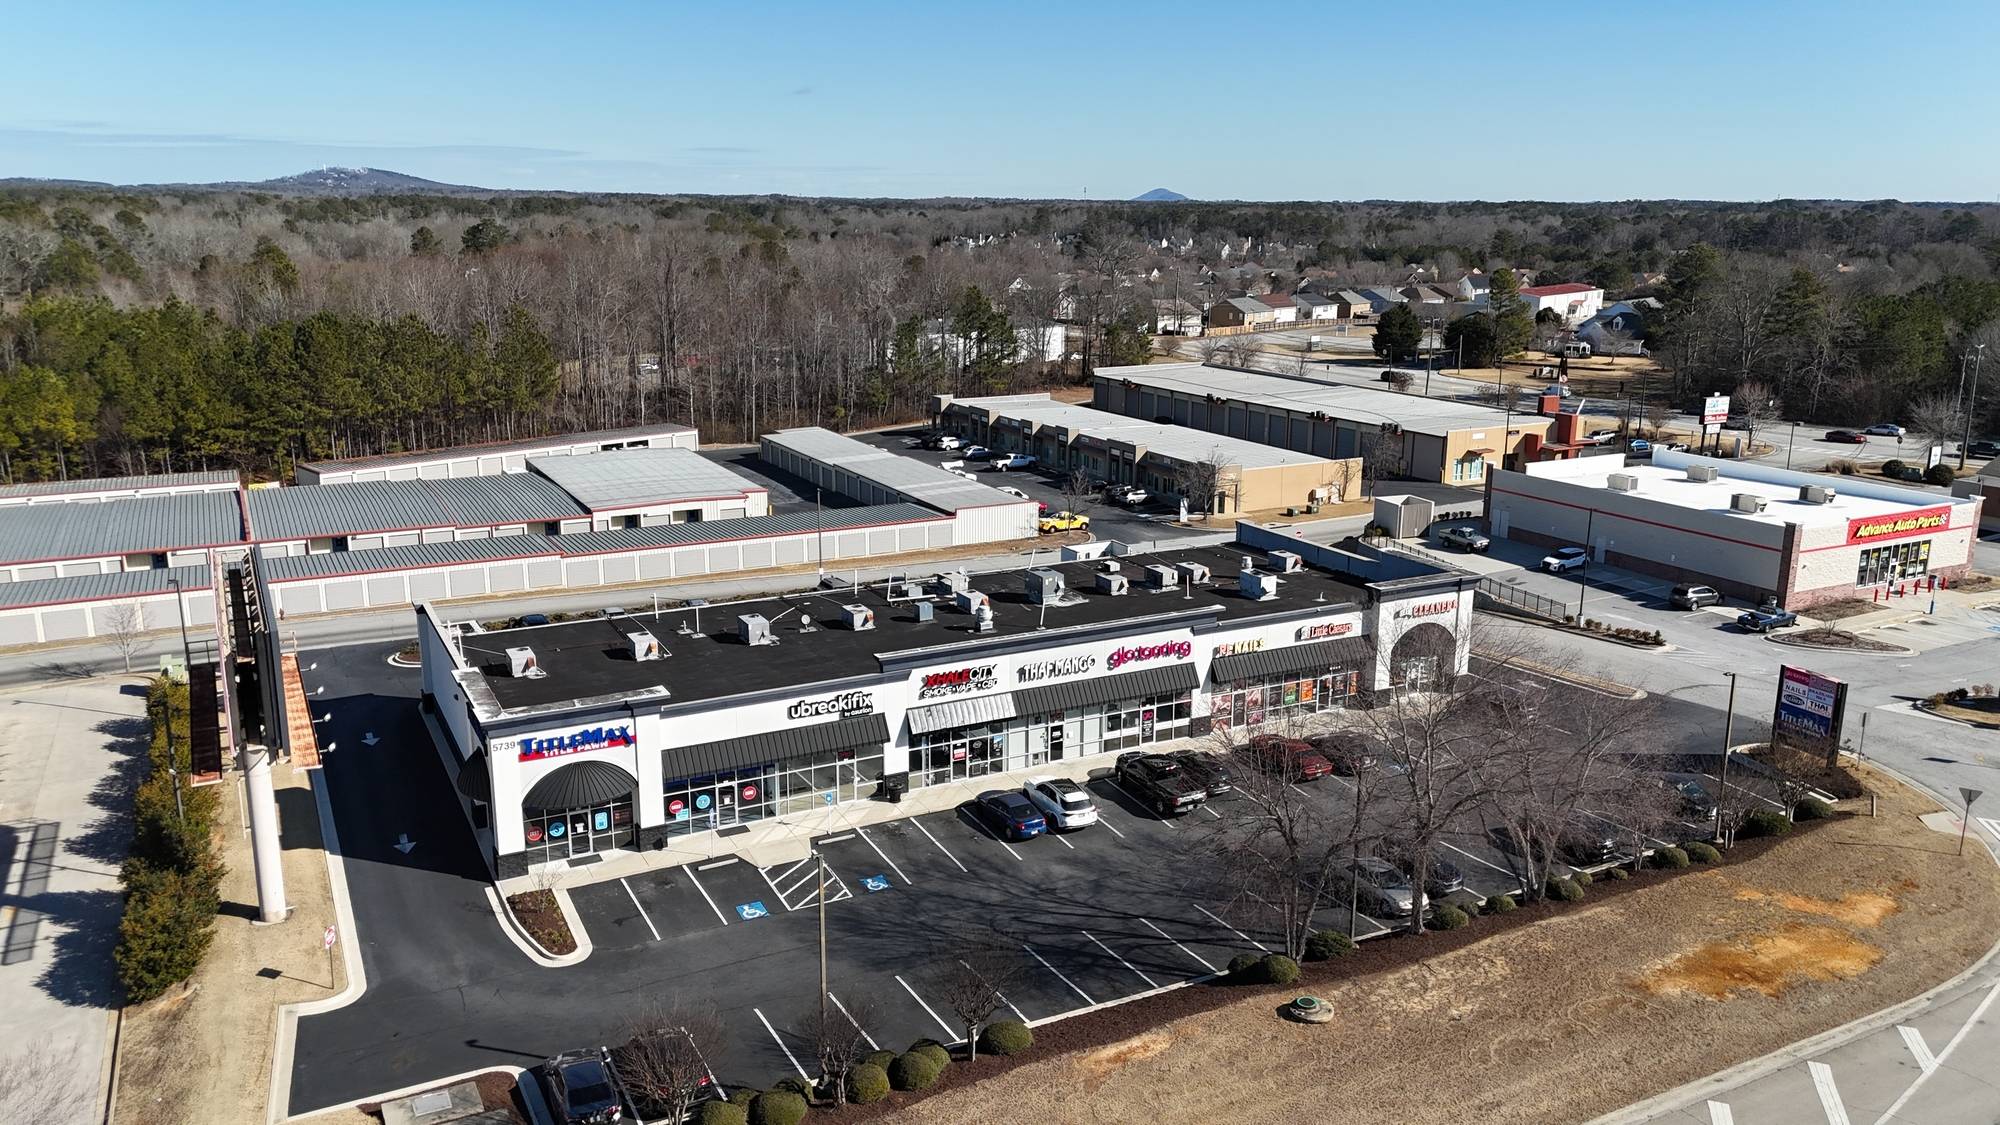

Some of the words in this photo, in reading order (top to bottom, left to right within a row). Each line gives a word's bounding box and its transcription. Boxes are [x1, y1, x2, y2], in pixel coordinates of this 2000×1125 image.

[1856, 523, 1894, 538] Advance
[1894, 519, 1916, 533] Auto
[1916, 515, 1941, 529] Parts
[1311, 626, 1328, 637] Little
[1328, 622, 1353, 635] Caesars
[1055, 655, 1095, 678] MANGO
[923, 686, 952, 699] SMOKE
[956, 682, 977, 693] VAPE
[1785, 684, 1807, 696] NAILS
[789, 691, 873, 718] ubreakifix
[1809, 700, 1829, 711] THAI
[492, 741, 516, 752] 5739
[543, 747, 574, 758] TITLE
[575, 740, 609, 753] PAWN
